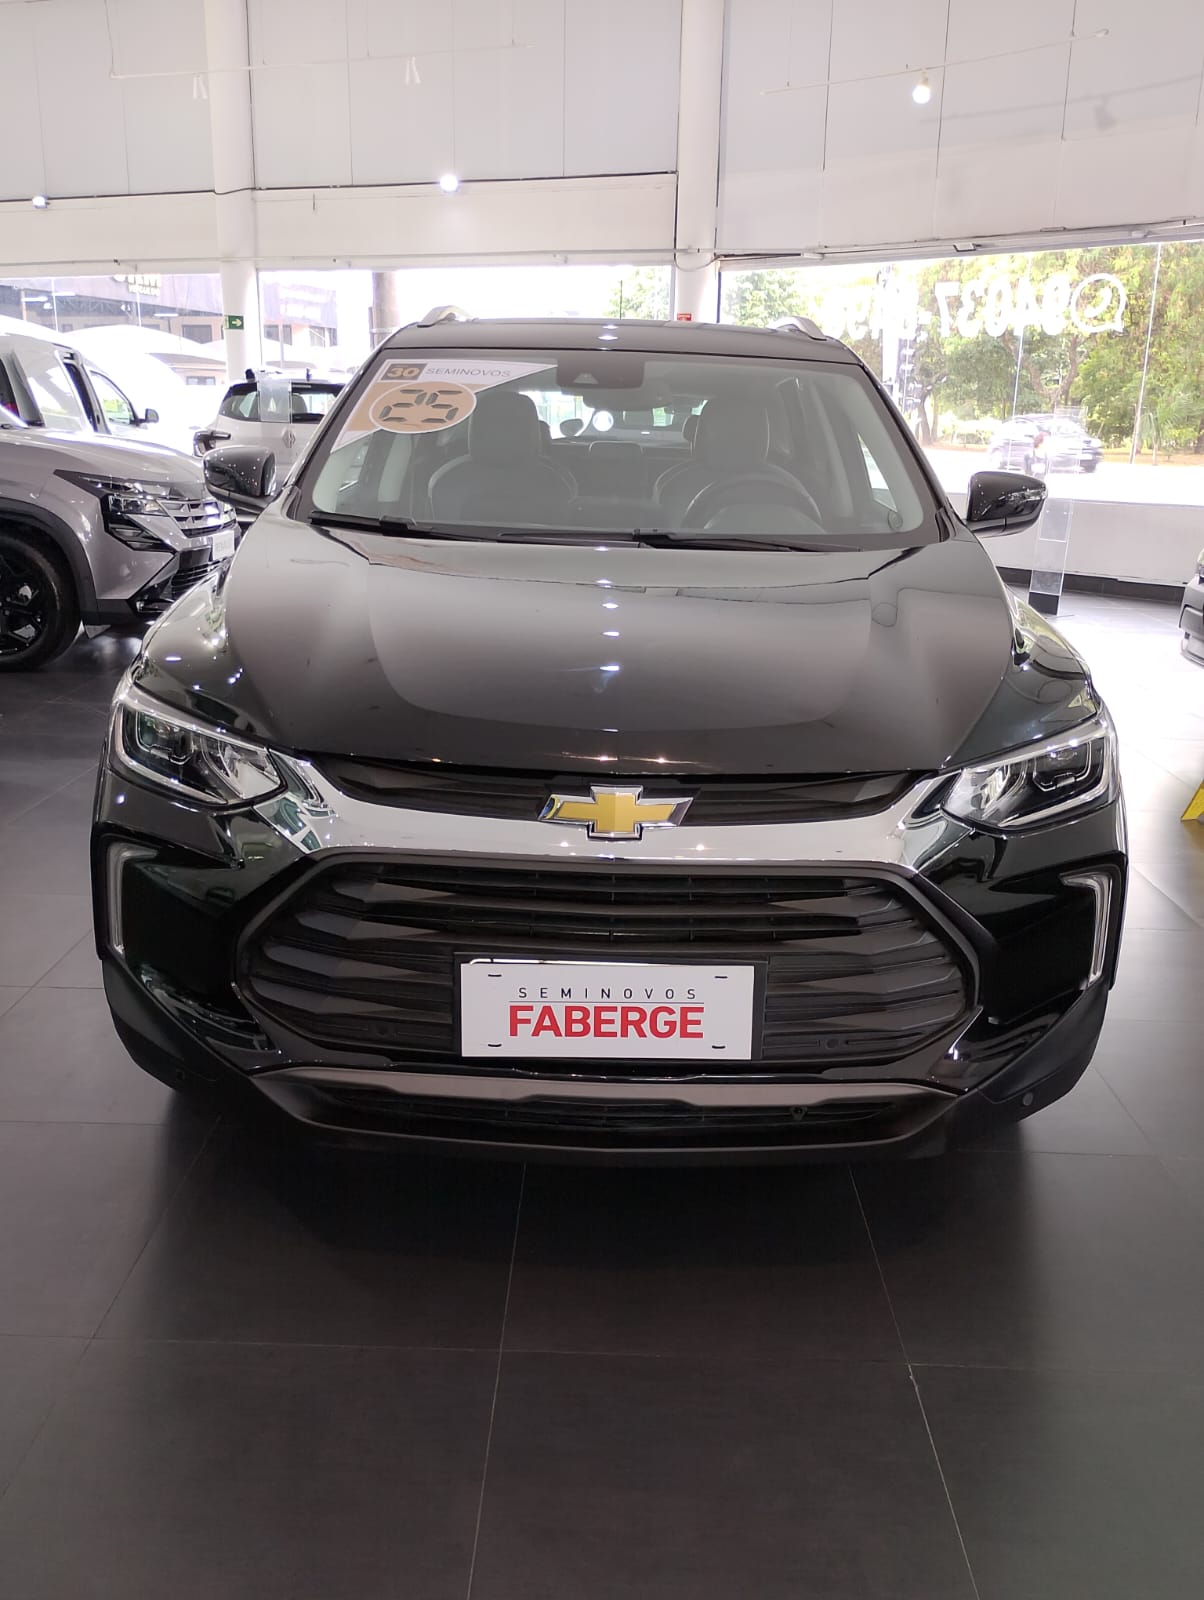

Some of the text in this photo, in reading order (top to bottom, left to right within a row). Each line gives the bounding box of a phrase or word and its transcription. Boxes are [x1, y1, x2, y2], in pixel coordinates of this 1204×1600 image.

[387, 367, 511, 378] 30 SEMINOVOS
[379, 389, 463, 423] 25
[518, 987, 697, 1000] SEMINOVOS
[509, 1005, 704, 1039] FABERGE
